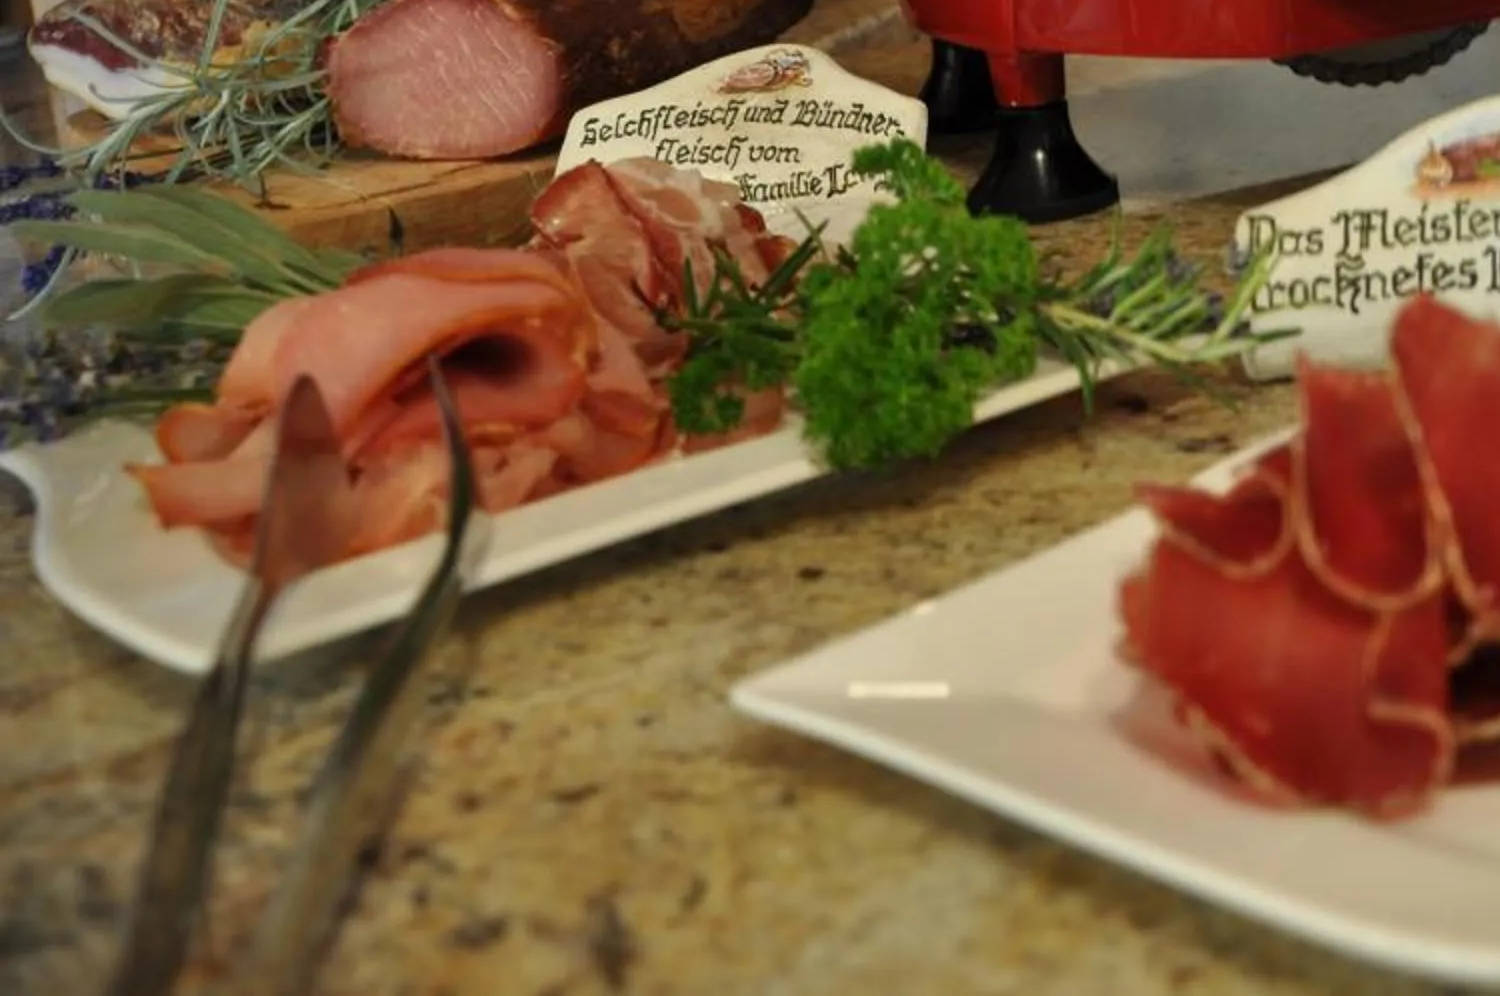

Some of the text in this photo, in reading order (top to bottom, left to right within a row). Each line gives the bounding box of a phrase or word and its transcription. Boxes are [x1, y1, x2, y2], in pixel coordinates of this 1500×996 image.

[580, 99, 905, 148] Selchfleisch und Bündner-
[655, 136, 801, 170] fleisch vom
[734, 170, 823, 202] Familie
[1247, 213, 1324, 257] Das
